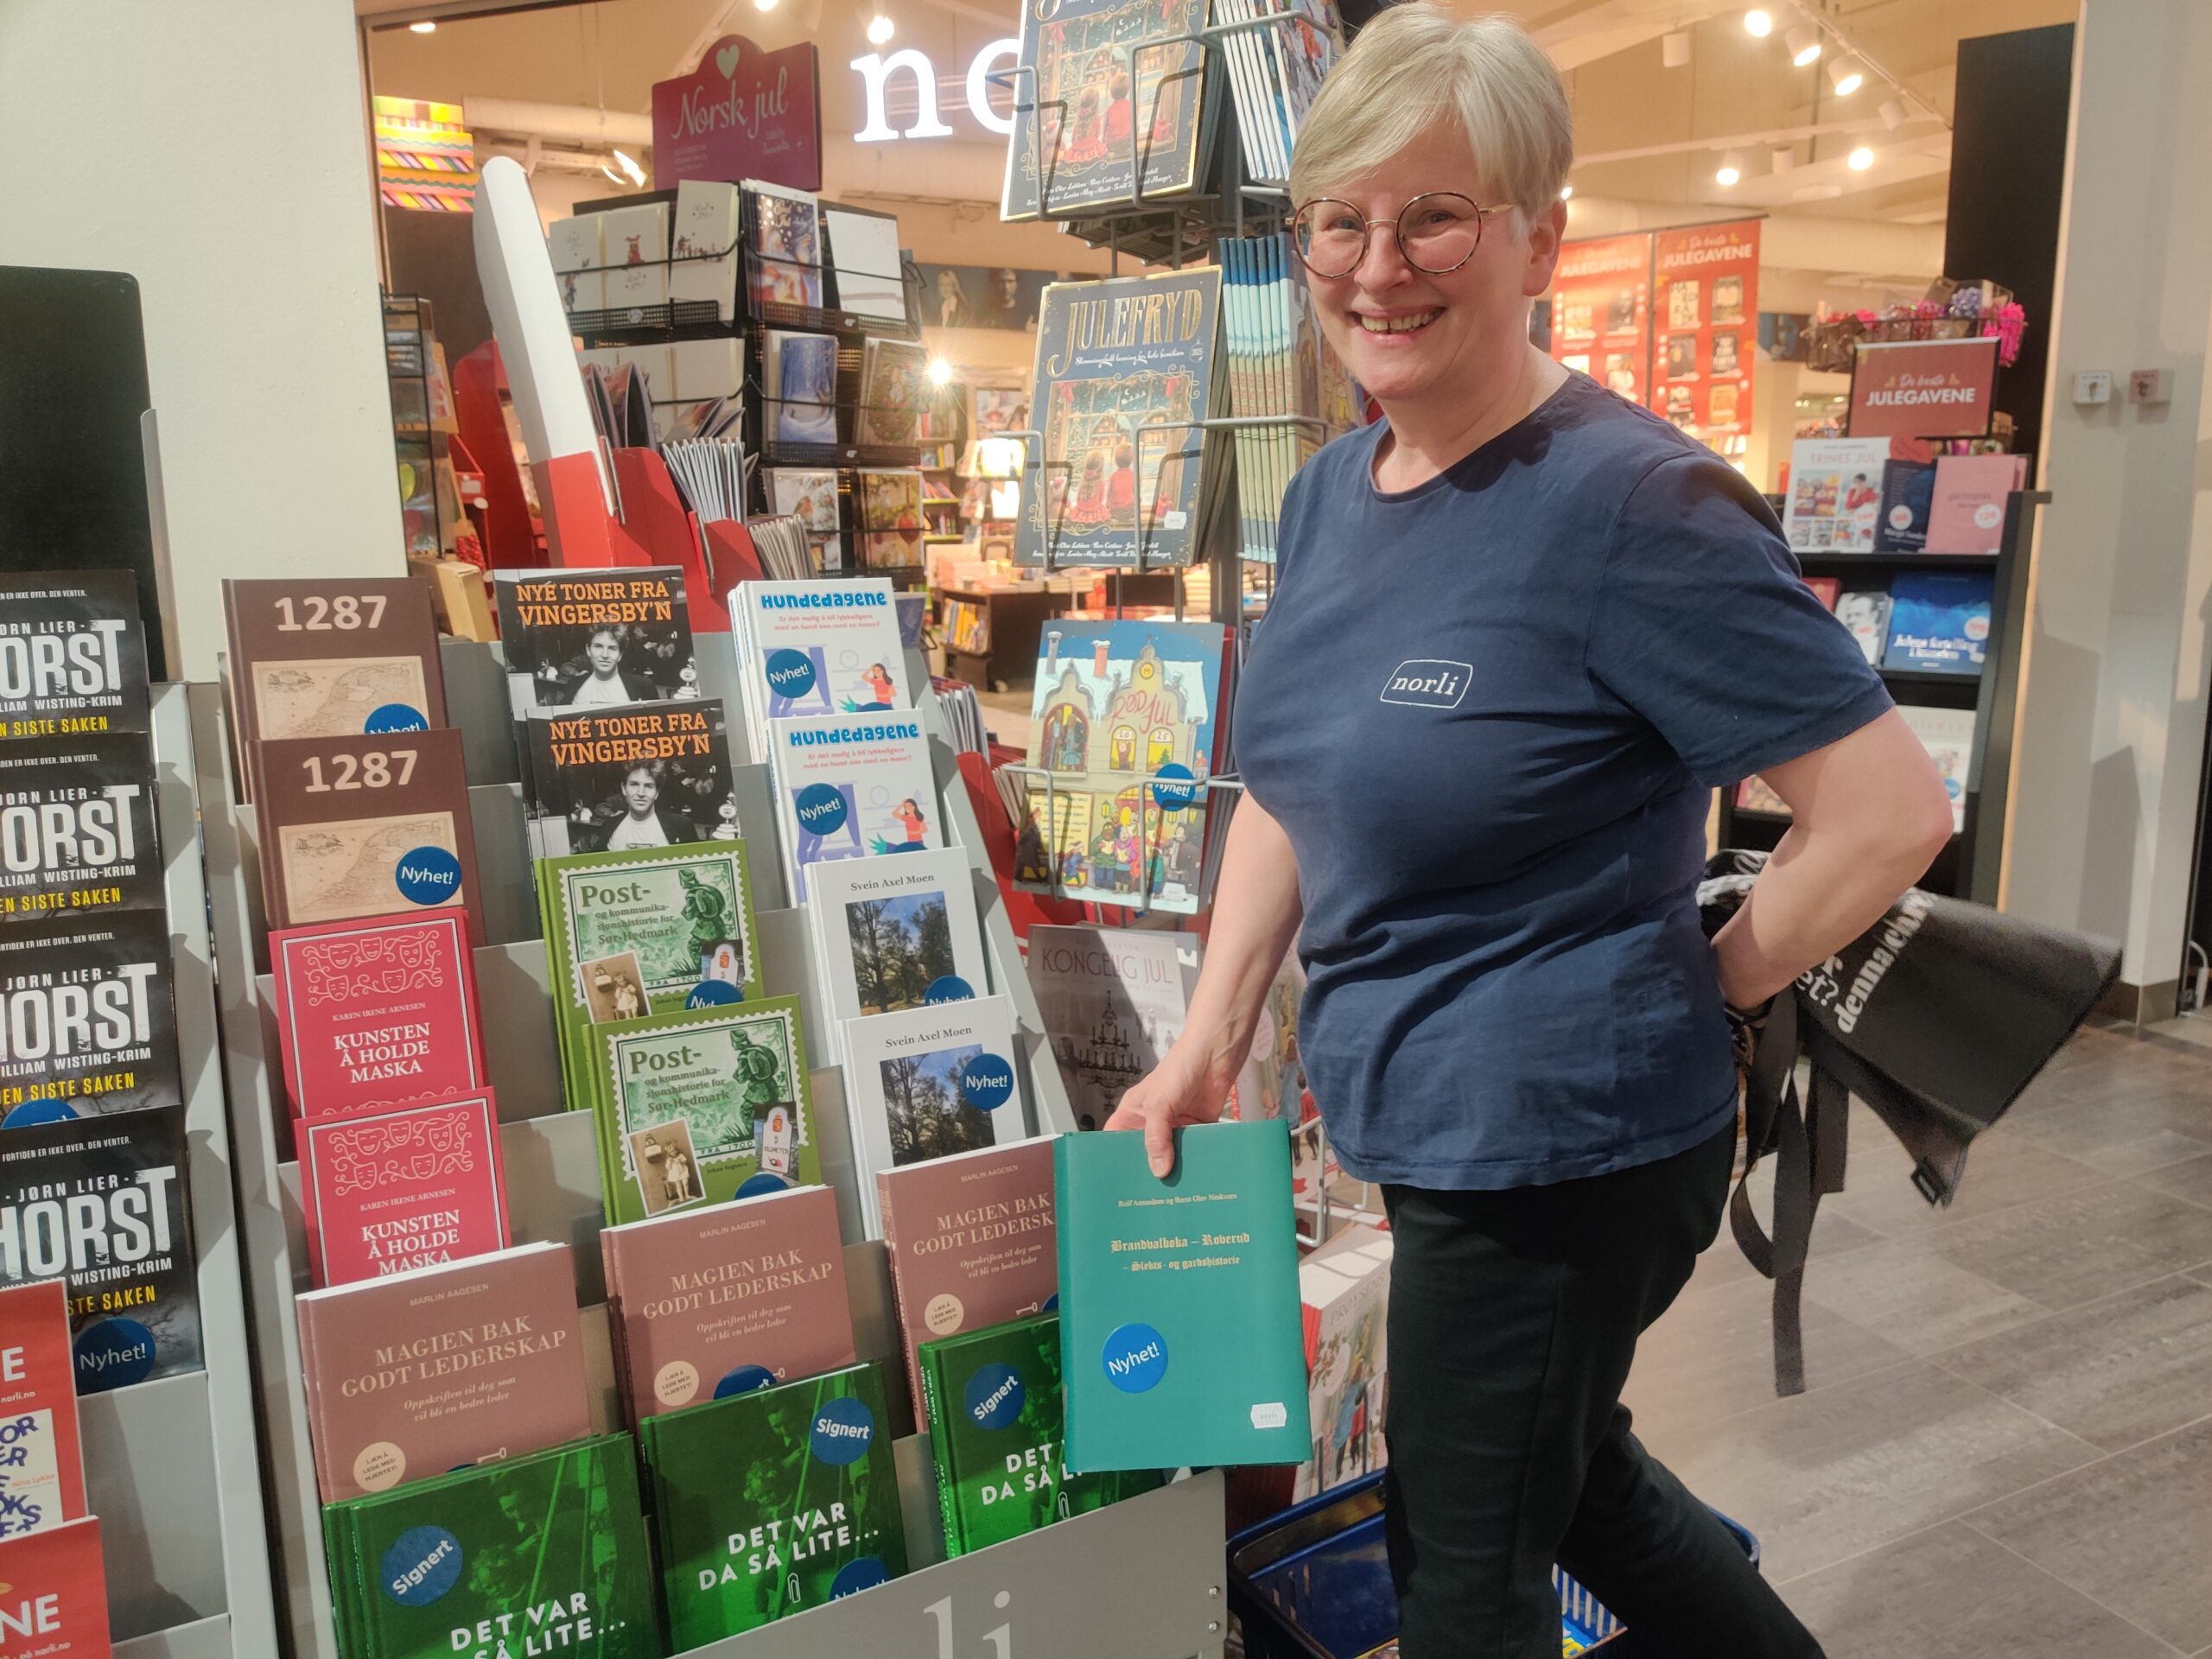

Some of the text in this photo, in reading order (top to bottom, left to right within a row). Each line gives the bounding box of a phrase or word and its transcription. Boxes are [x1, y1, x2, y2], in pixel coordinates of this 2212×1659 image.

[671, 67, 788, 141] Norsk jul
[1560, 254, 1643, 278] JULEGAVENE
[1662, 243, 1753, 269] JULEGAVENE
[1046, 289, 1204, 378] JULEFRYD
[1866, 387, 1976, 406] JULEGAVENE
[516, 580, 670, 603] NYE TONER FRA
[761, 592, 887, 610] Hundedagene
[41, 619, 76, 635] LIER
[274, 595, 388, 632] 1287
[518, 601, 672, 627] VINGERSBY'N
[0, 619, 126, 700] ORST
[770, 664, 810, 685] Nyhet!
[1391, 671, 1459, 696] norli
[34, 695, 123, 711] WISTING-KRIM
[14, 715, 108, 736] SISTE SAKEN
[550, 712, 709, 741] NYE TONER FRA
[790, 723, 920, 747] Hundedagene
[550, 733, 711, 766] VINGERSBY'N
[302, 750, 418, 793] 1287
[50, 789, 87, 803] LIER
[800, 798, 842, 822] Nyhet!
[1, 784, 140, 874] ORST
[43, 865, 137, 885] WISTING-KRIM
[401, 865, 454, 886] Nyhet!
[851, 873, 934, 892] Svein Axel Moen
[22, 887, 121, 911] SISTE SAKEN
[580, 881, 652, 907] Post-
[26, 931, 115, 950] ER IKKE OVER. DEN VENTER.
[598, 925, 678, 947] Sør-Hedmark
[6, 968, 102, 991] JØRN LIER
[1042, 948, 1173, 985] KONGELIG JUL
[650, 974, 701, 987] FRA 1700
[333, 1001, 426, 1022] KAREN IRENE ARNESEN
[334, 1021, 430, 1051] KUNSTEN
[885, 1026, 972, 1048] Svein Axel Moen
[54, 1047, 151, 1071] WISTING-KRIM
[340, 1040, 430, 1067] Å HOLDE
[629, 1045, 702, 1075] Post-
[350, 1059, 423, 1084] MASKA
[645, 1066, 721, 1087] og kommunika-
[966, 1074, 1007, 1090] Nyhet!
[30, 1072, 135, 1101] SISTE SAKEN
[646, 1077, 726, 1098] sjonshistorie for
[648, 1090, 730, 1114] Sør-Hedmark
[2, 1135, 132, 1163] FORTIDEN ER IKKE OVER. DEN VENTER.
[728, 1141, 753, 1150] 1700
[18, 1174, 119, 1203] JØRN LIER
[938, 1192, 1051, 1232] MAGIEN BAK
[361, 1210, 461, 1243] KUNSTEN
[699, 1218, 766, 1238] MARLIN AAGESEN
[913, 1211, 1055, 1256] GODT LEDERSK
[1202, 1232, 1250, 1246] Roverud
[367, 1229, 460, 1260] Å HOLDE
[70, 1257, 172, 1287] WISTING-KRIM
[378, 1249, 451, 1276] MASKA
[670, 1249, 804, 1293] MAGIEN BAK
[102, 1284, 156, 1312] SAKEN
[410, 1282, 489, 1307] MARLIN AAGESEN
[643, 1262, 834, 1320] GODT LEDERSKAP
[374, 1314, 533, 1367] MAGIEN BAK
[79, 1342, 147, 1372] Nyhet!
[341, 1329, 568, 1398] GODT LEDERSKAP
[1108, 1341, 1160, 1376] Nyhet!
[404, 1386, 461, 1410] Oppskriften
[465, 1382, 477, 1395] til
[478, 1380, 496, 1394] deg
[413, 1391, 510, 1422] vil bli en bedre leder
[974, 1375, 1019, 1421] Signert
[816, 1417, 869, 1441] Signert
[1006, 1441, 1053, 1473] DET
[981, 1481, 1016, 1506] DA
[1024, 1463, 1054, 1493] SÅ
[728, 1501, 847, 1555] DET VAR
[392, 1539, 454, 1597] Signert
[698, 1526, 880, 1591] DA SÅ LITE...
[450, 1592, 588, 1650] DET VAR
[35, 1641, 71, 1658] norli.no
[525, 1617, 626, 1657] LITE...
